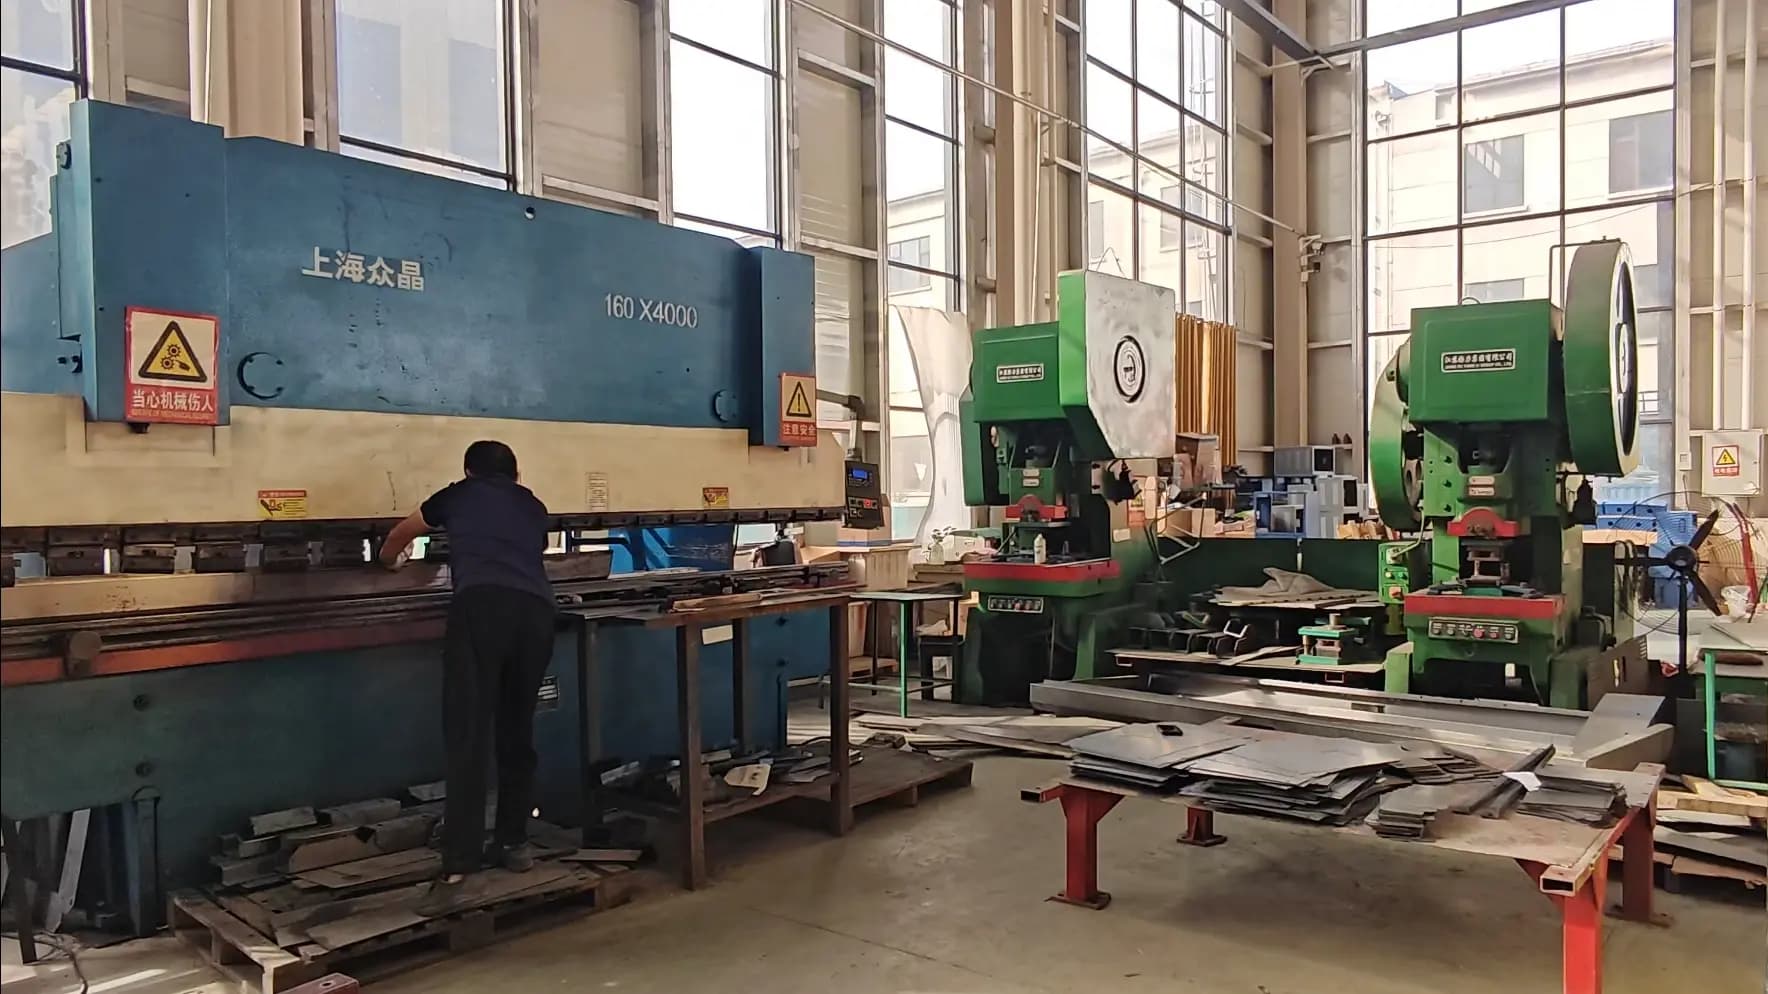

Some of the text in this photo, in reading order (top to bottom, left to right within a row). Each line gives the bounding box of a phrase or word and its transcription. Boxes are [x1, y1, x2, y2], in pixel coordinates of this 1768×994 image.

[301, 246, 424, 291] 上海众晶
[605, 293, 698, 328] 160 X4000
[132, 388, 214, 412] 当心机械伤人
[783, 423, 817, 437] 注意安全
